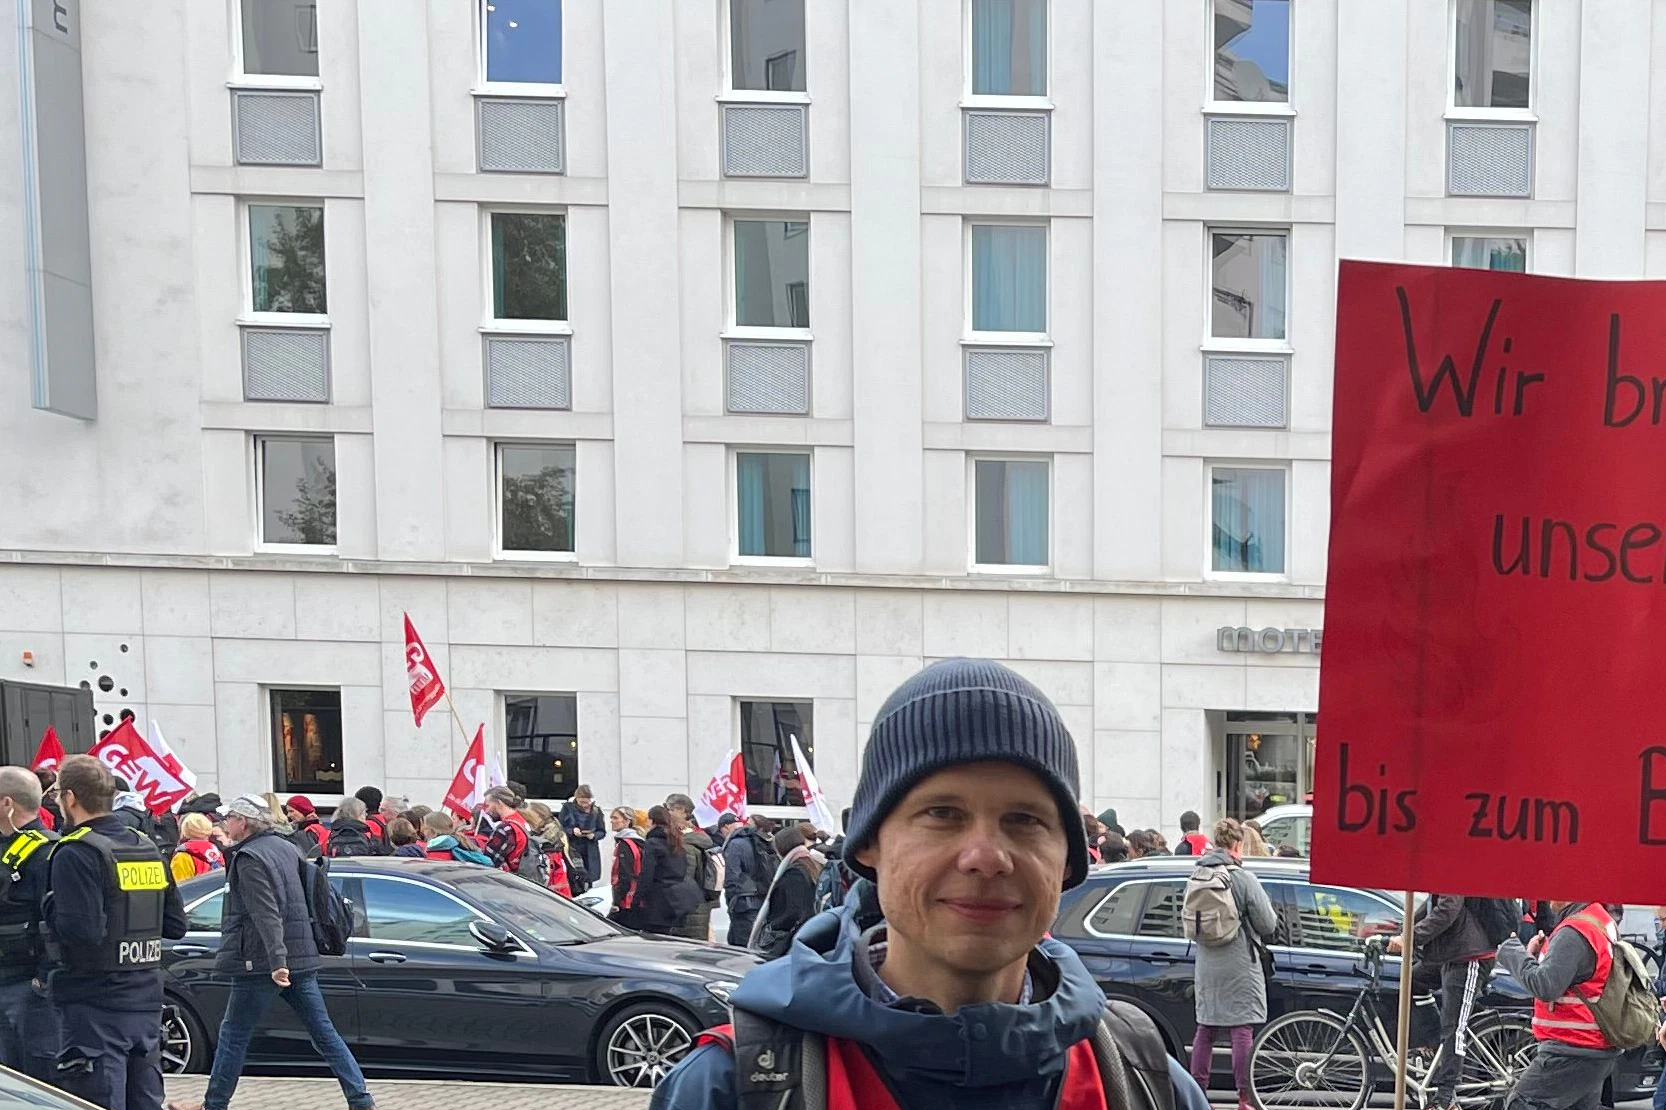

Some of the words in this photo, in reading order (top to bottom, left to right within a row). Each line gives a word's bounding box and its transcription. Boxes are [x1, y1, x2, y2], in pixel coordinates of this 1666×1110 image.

[1396, 286, 1545, 417] Wir
[99, 743, 173, 806] GEW
[1338, 742, 1417, 836] bis
[1467, 792, 1578, 845] zum
